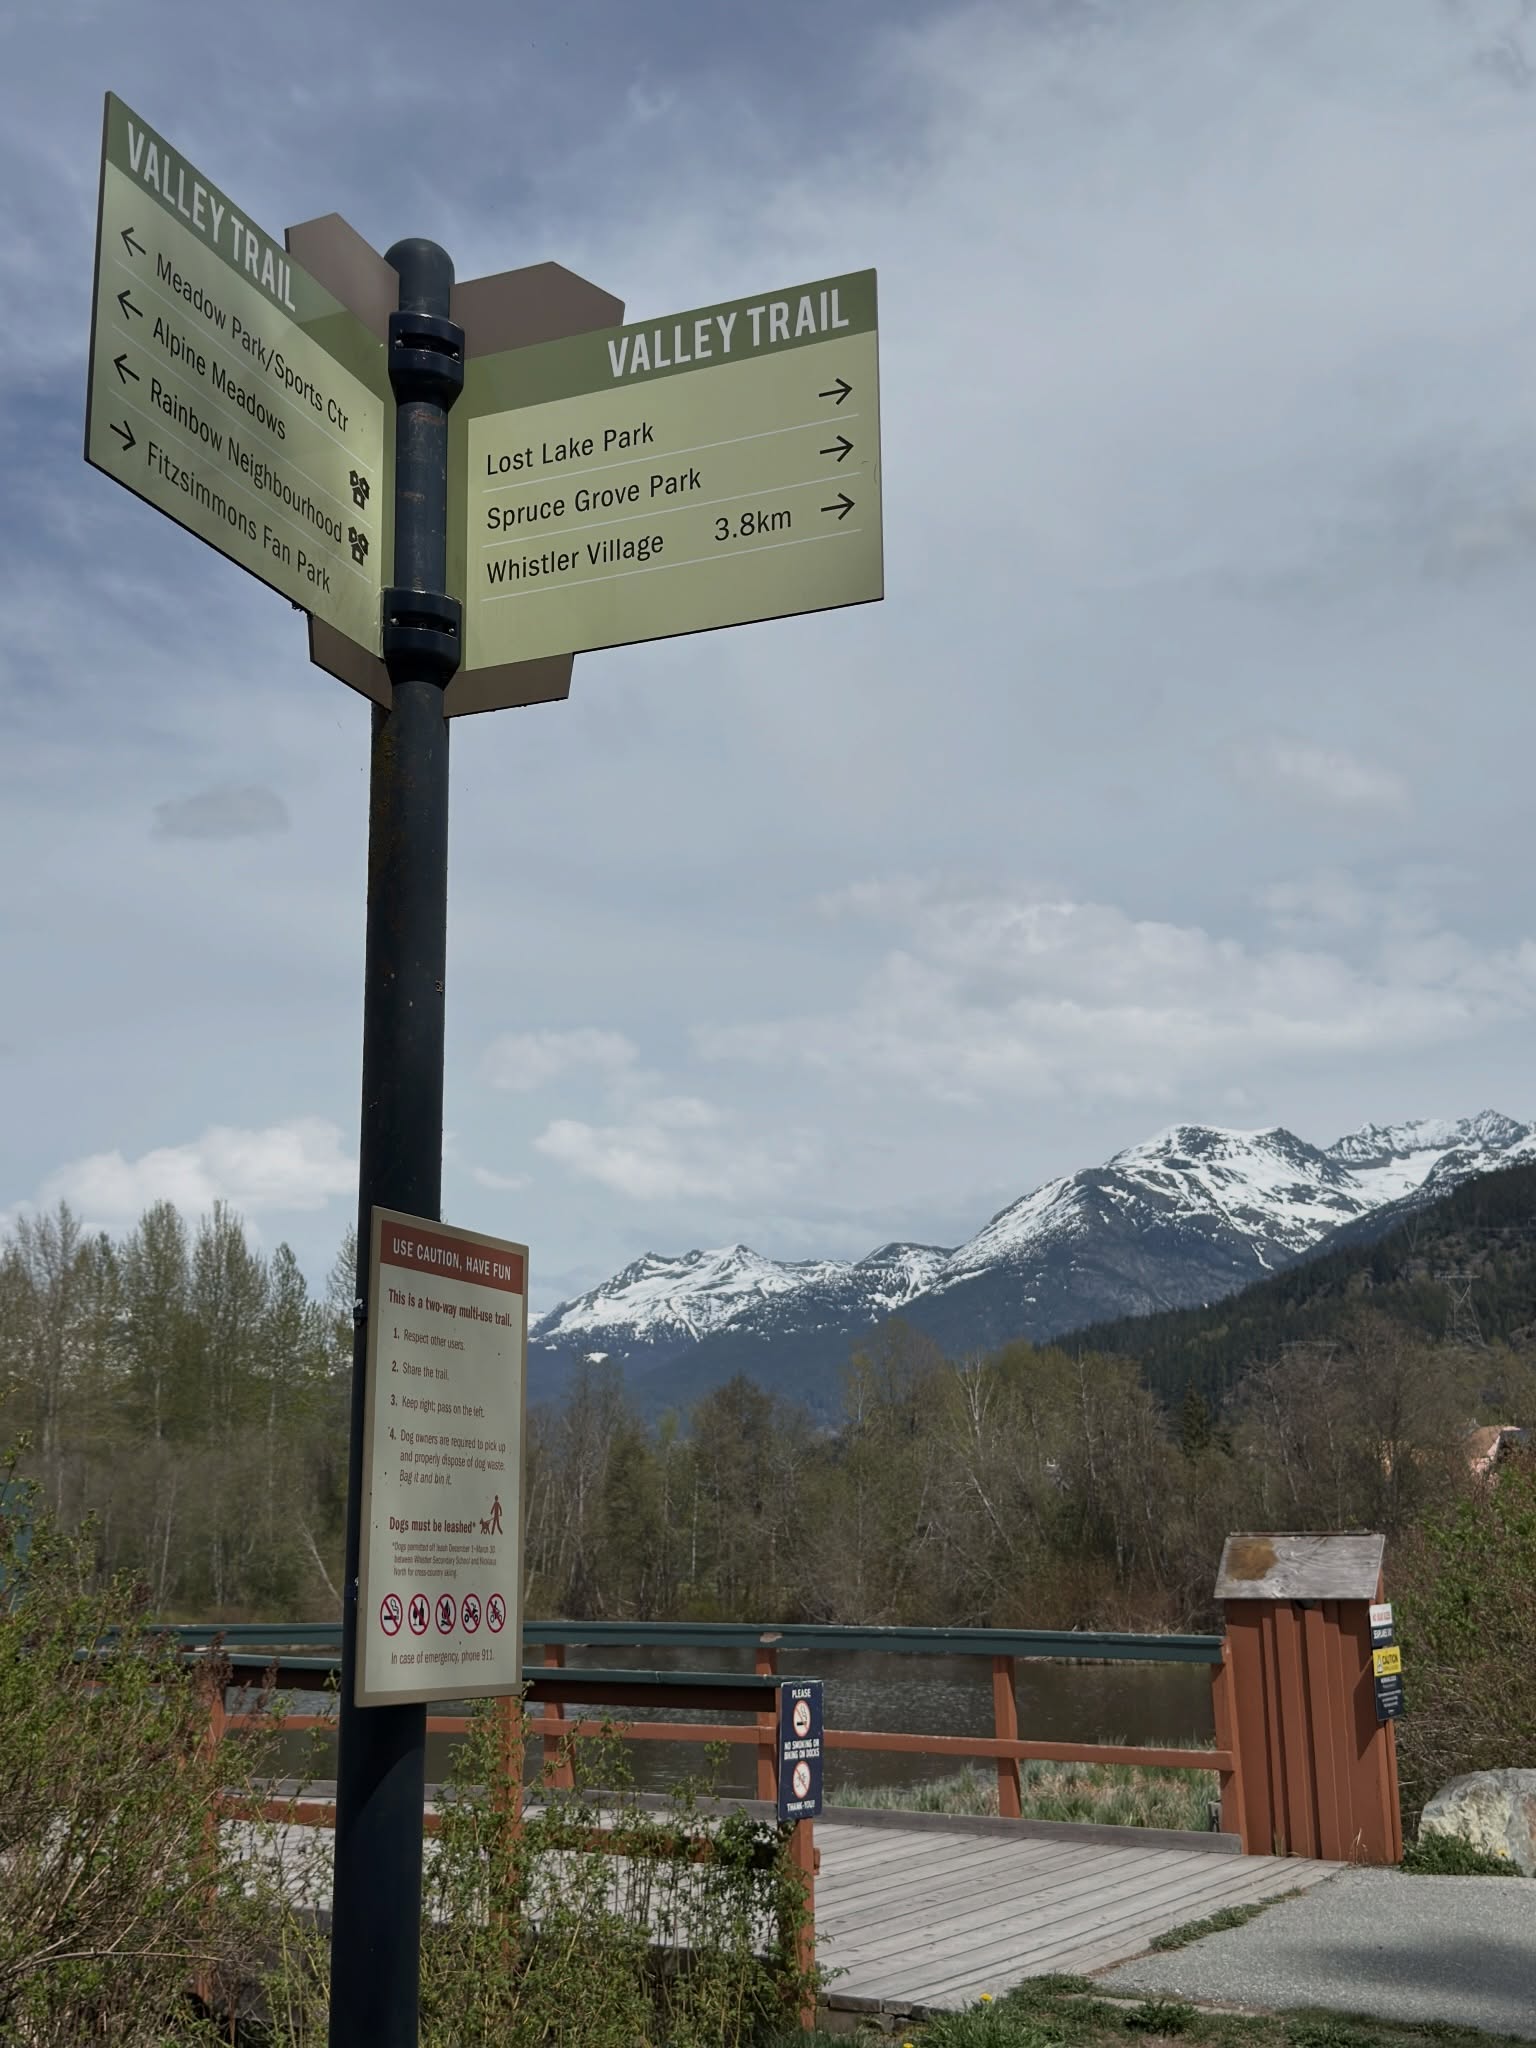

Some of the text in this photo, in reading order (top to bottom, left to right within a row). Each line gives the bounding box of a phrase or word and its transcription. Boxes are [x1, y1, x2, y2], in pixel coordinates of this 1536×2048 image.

[127, 121, 296, 312] VALLEY TRAIL
[157, 253, 348, 433] Meadow Park/Sports Ctr
[607, 288, 849, 377] VALLEY TRAIL
[153, 316, 286, 440] Alpine Meadows
[151, 378, 343, 544] Rainbow Neighbourhood
[487, 422, 654, 476] Lost Lake Park
[148, 441, 330, 593] Fitzsimmons Fan Park
[487, 468, 702, 531] Spruce Grove Park
[487, 510, 792, 584] Whistler Village 3.8km
[393, 1237, 511, 1281] USE CAUTION, HAVE FUN
[388, 1288, 512, 1328] This is a two-way multi-use trail.
[393, 1327, 466, 1352] 1. Respect other users.
[391, 1360, 399, 1373] 2.
[402, 1361, 422, 1376] Share
[423, 1365, 434, 1378] the
[390, 1394, 398, 1407] 3.
[402, 1395, 419, 1411] Keep
[437, 1403, 452, 1414] pass
[453, 1406, 461, 1414] on
[462, 1405, 473, 1416] the
[389, 1427, 506, 1454] 4. Dog owners are required to pick up
[400, 1451, 413, 1462] and
[414, 1452, 440, 1467] properly
[441, 1454, 465, 1468] dispose
[467, 1456, 474, 1467] of
[474, 1457, 486, 1471] dog
[400, 1469, 413, 1485] Bag
[420, 1472, 432, 1484] and
[389, 1517, 409, 1533] Dogs
[411, 1519, 431, 1532] must
[432, 1519, 442, 1532] be
[391, 1652, 398, 1665] In
[400, 1653, 415, 1665] case
[416, 1651, 423, 1664] of
[461, 1649, 480, 1663] phone
[792, 1688, 811, 1698] PLEASE
